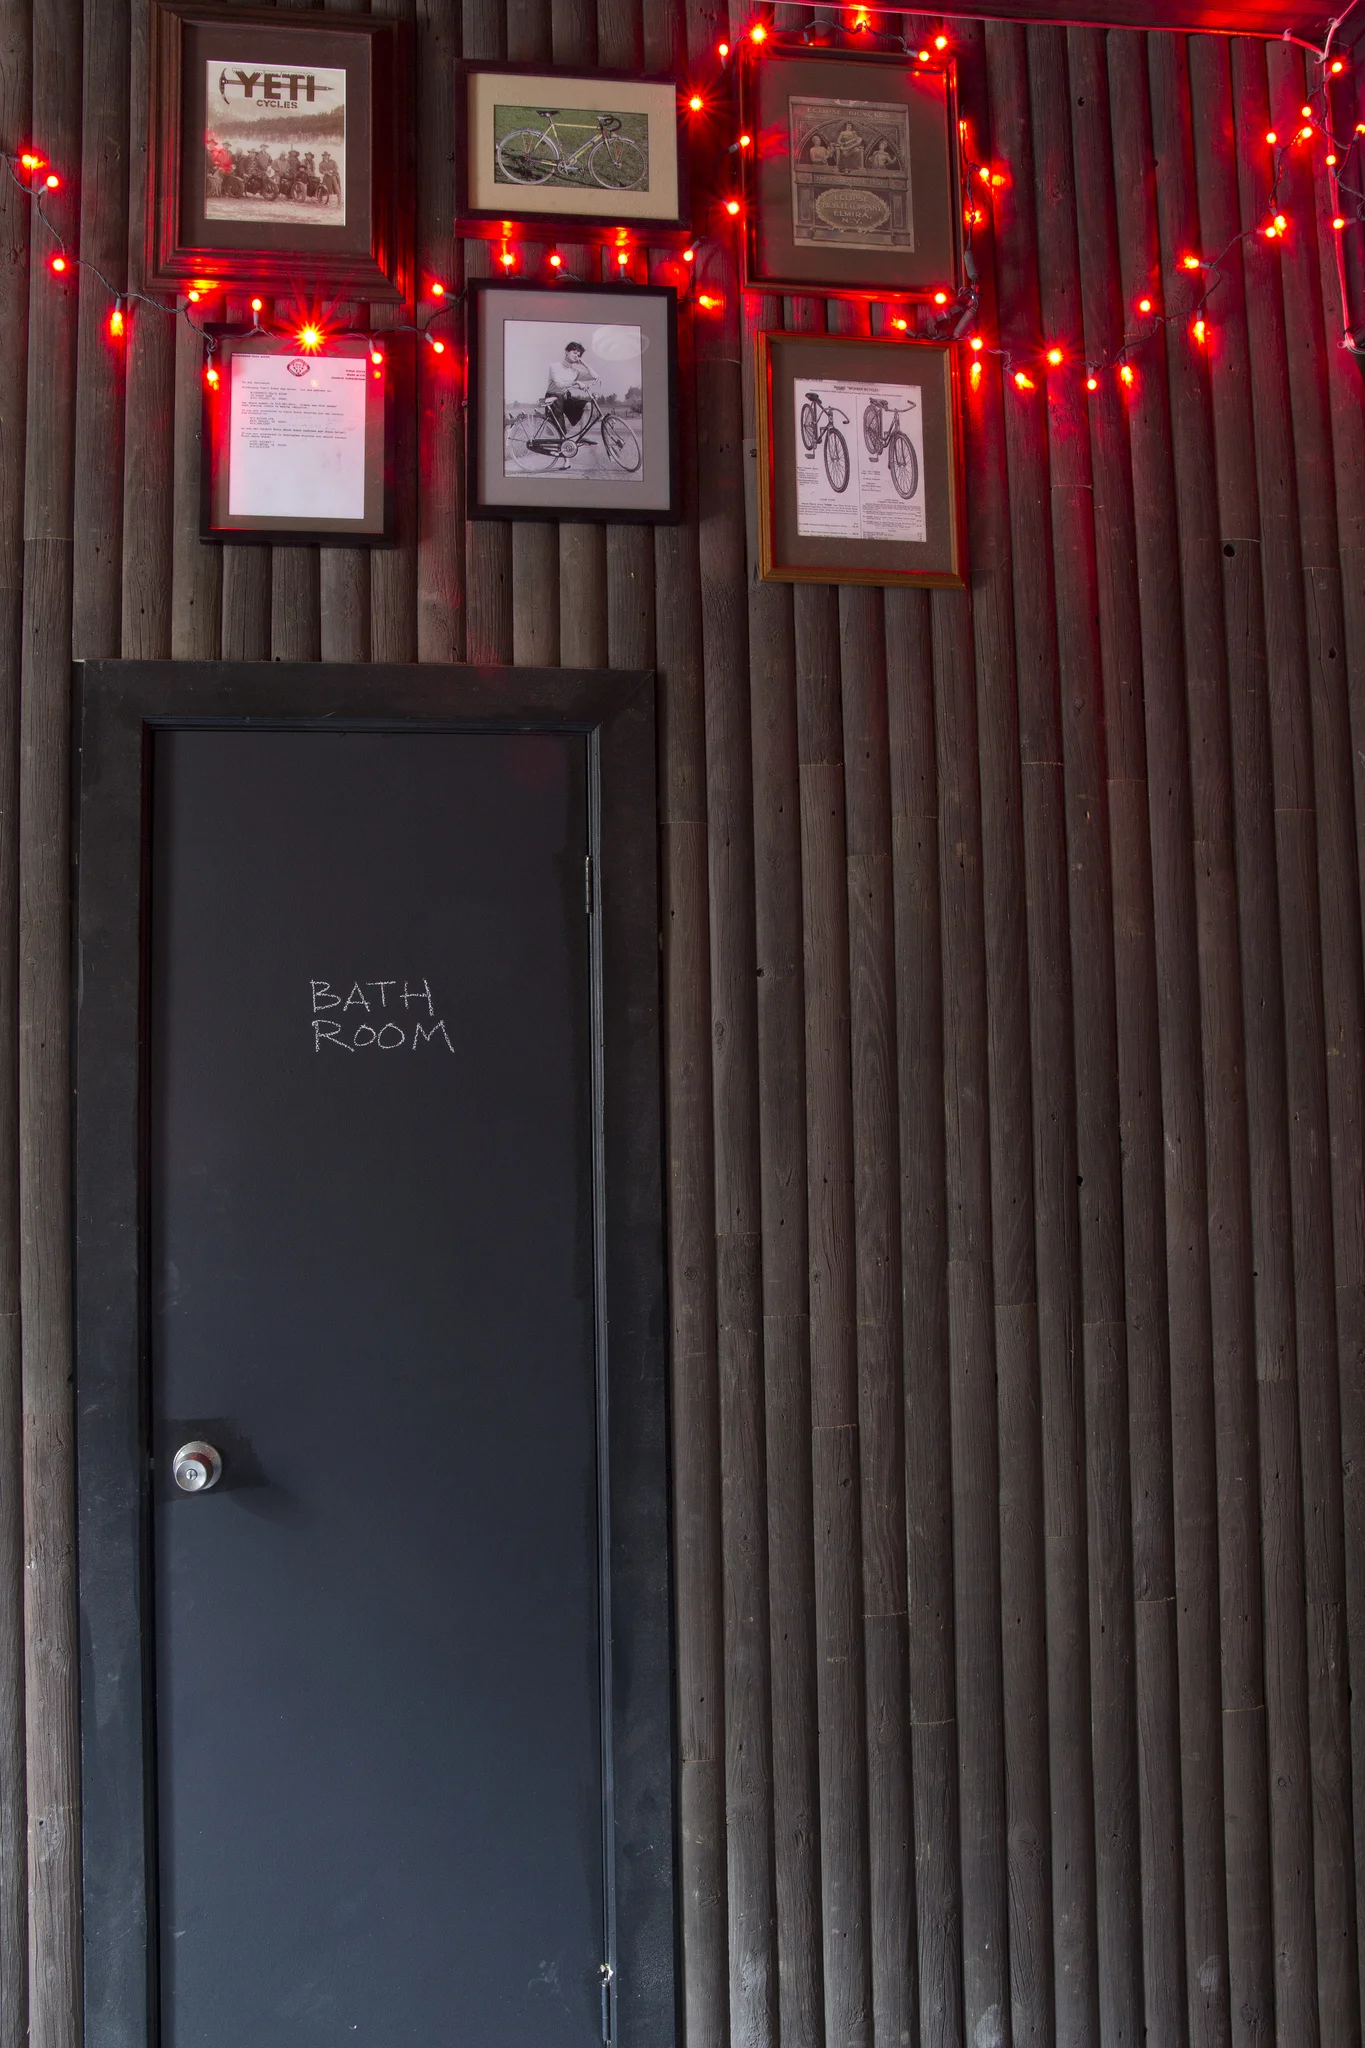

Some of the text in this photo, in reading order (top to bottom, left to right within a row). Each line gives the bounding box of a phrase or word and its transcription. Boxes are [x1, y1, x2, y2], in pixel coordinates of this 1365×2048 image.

[232, 68, 315, 102] YETI
[256, 99, 298, 109] CYCLES
[807, 107, 841, 116] ECLIPSE
[834, 194, 869, 203] ECLIPSE
[849, 203, 882, 212] COMPANY
[833, 210, 872, 219] ELMIRA,
[309, 977, 434, 1017] BATH
[311, 1019, 455, 1053] ROOM
